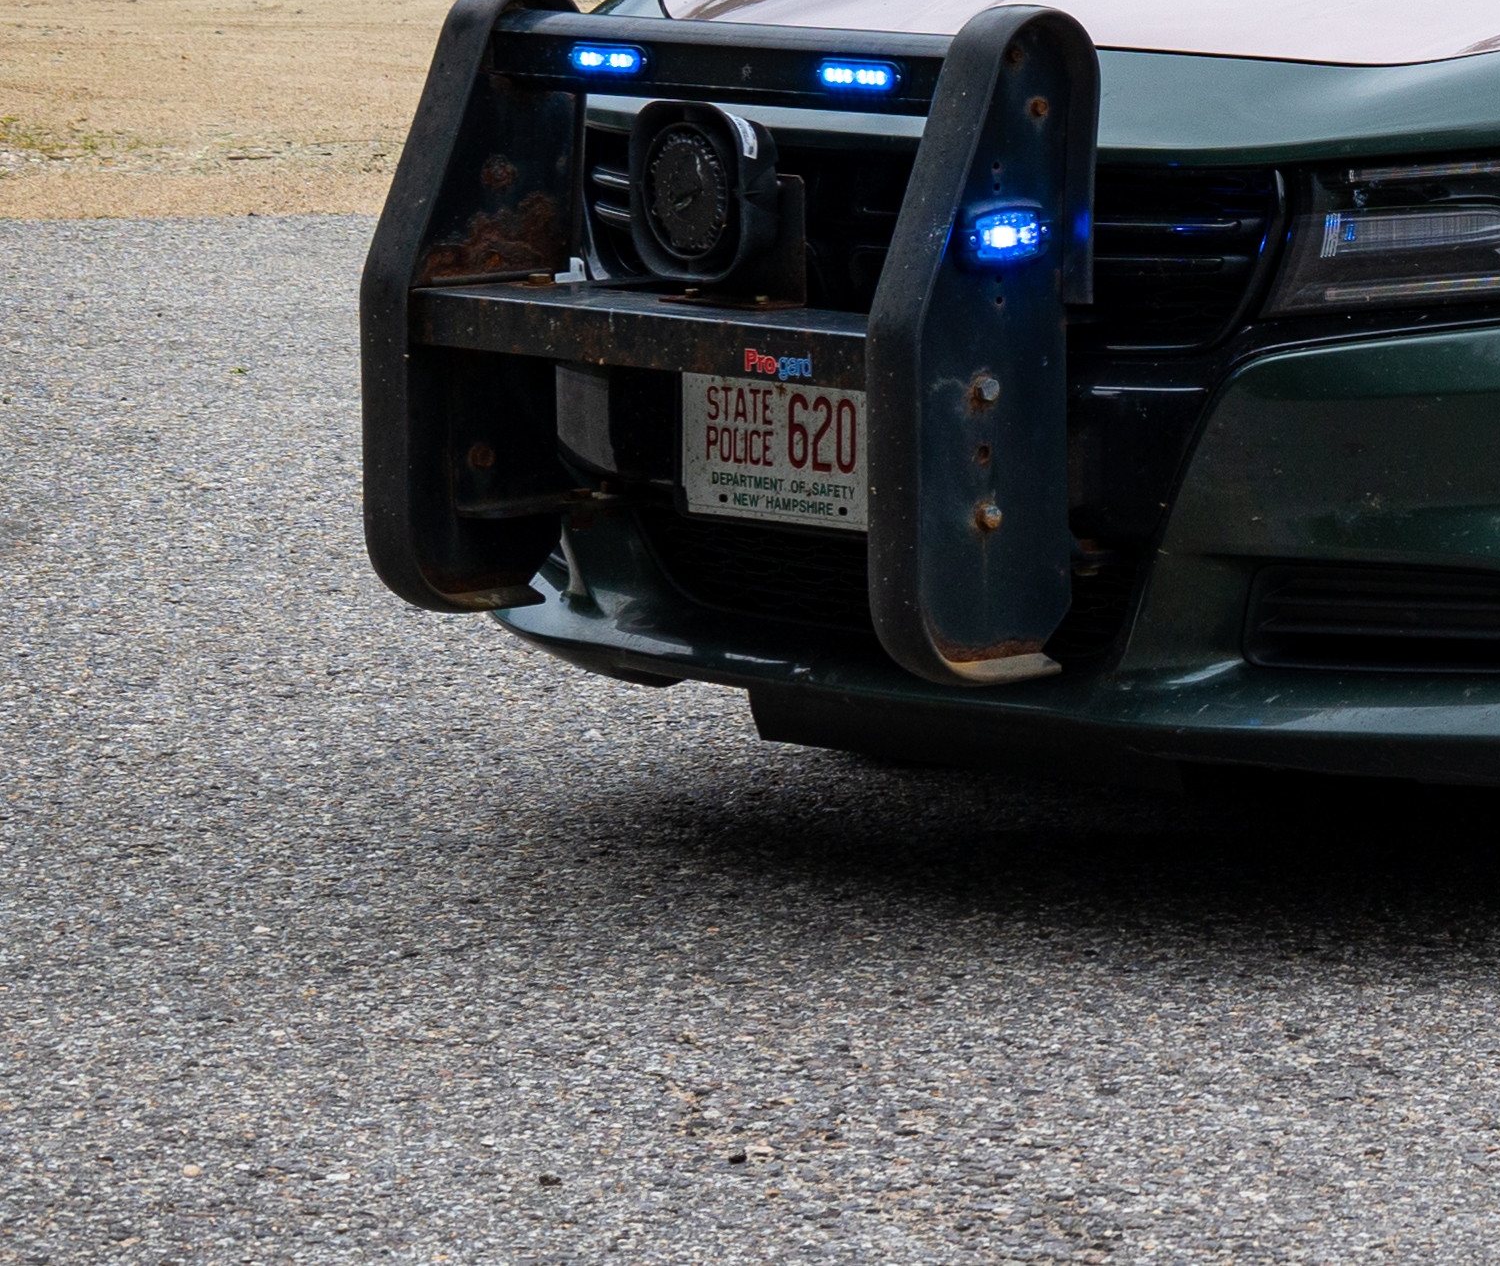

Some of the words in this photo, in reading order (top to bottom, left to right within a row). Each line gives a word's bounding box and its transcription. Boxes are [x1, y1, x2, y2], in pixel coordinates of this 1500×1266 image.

[707, 386, 773, 426] STATE
[706, 425, 774, 467] POLICE
[788, 393, 857, 474] 620
[711, 471, 785, 493] DEPARTMENT
[790, 479, 806, 494] OF
[811, 482, 856, 500] SAFETY
[733, 493, 761, 507] NEW
[766, 495, 834, 517] HAMPSHIRE
